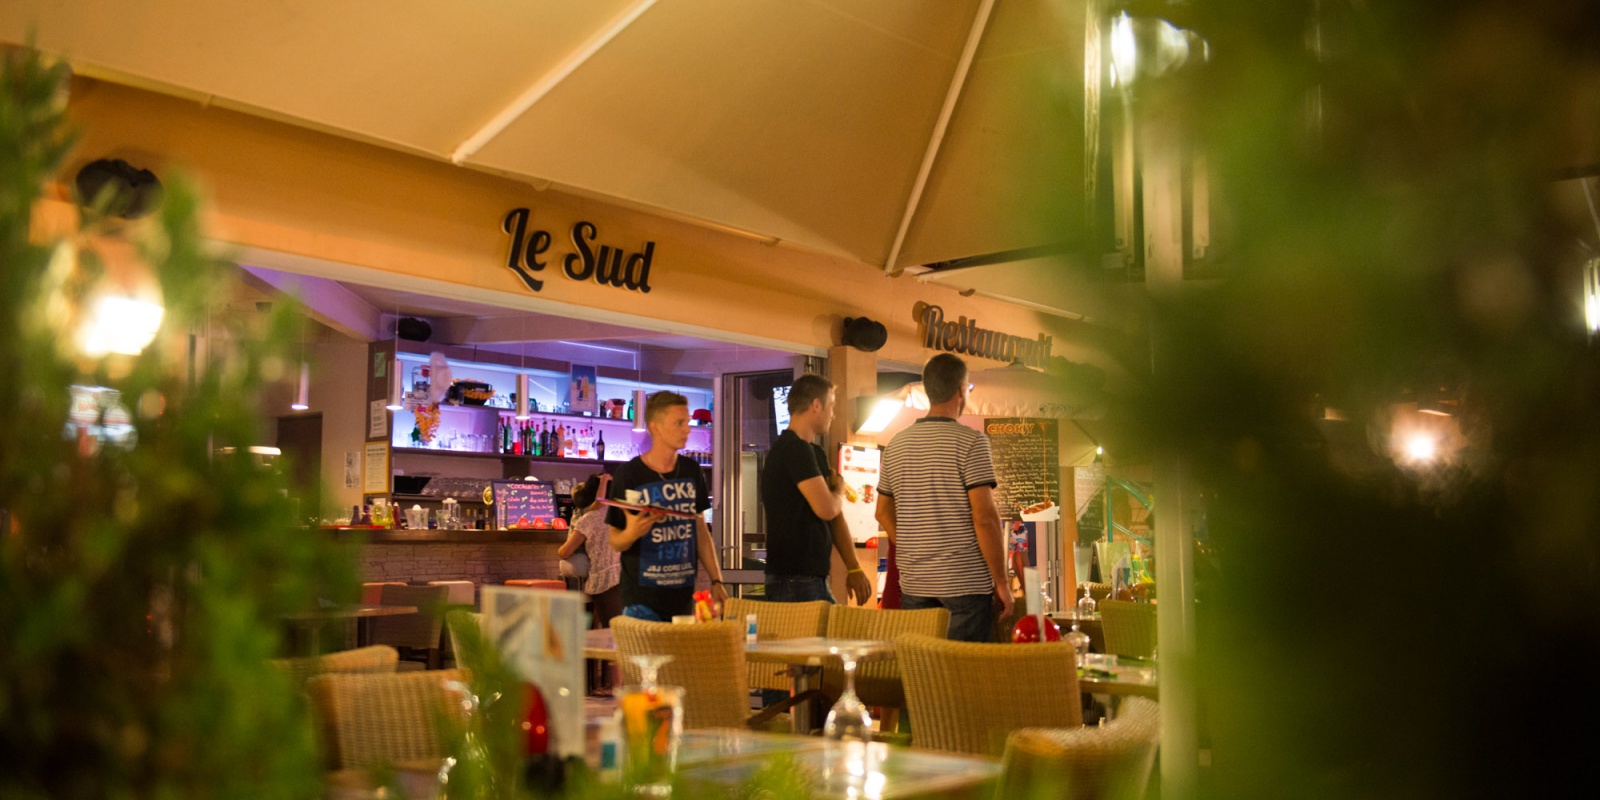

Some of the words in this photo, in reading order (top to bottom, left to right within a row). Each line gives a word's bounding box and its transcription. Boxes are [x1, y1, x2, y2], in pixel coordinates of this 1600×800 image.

[502, 208, 551, 292] Le
[562, 221, 655, 293] Sud
[922, 304, 1053, 368] Restaurant
[987, 423, 1034, 434] CHOKY
[639, 482, 696, 505] JACK&
[652, 524, 692, 543] SINCE
